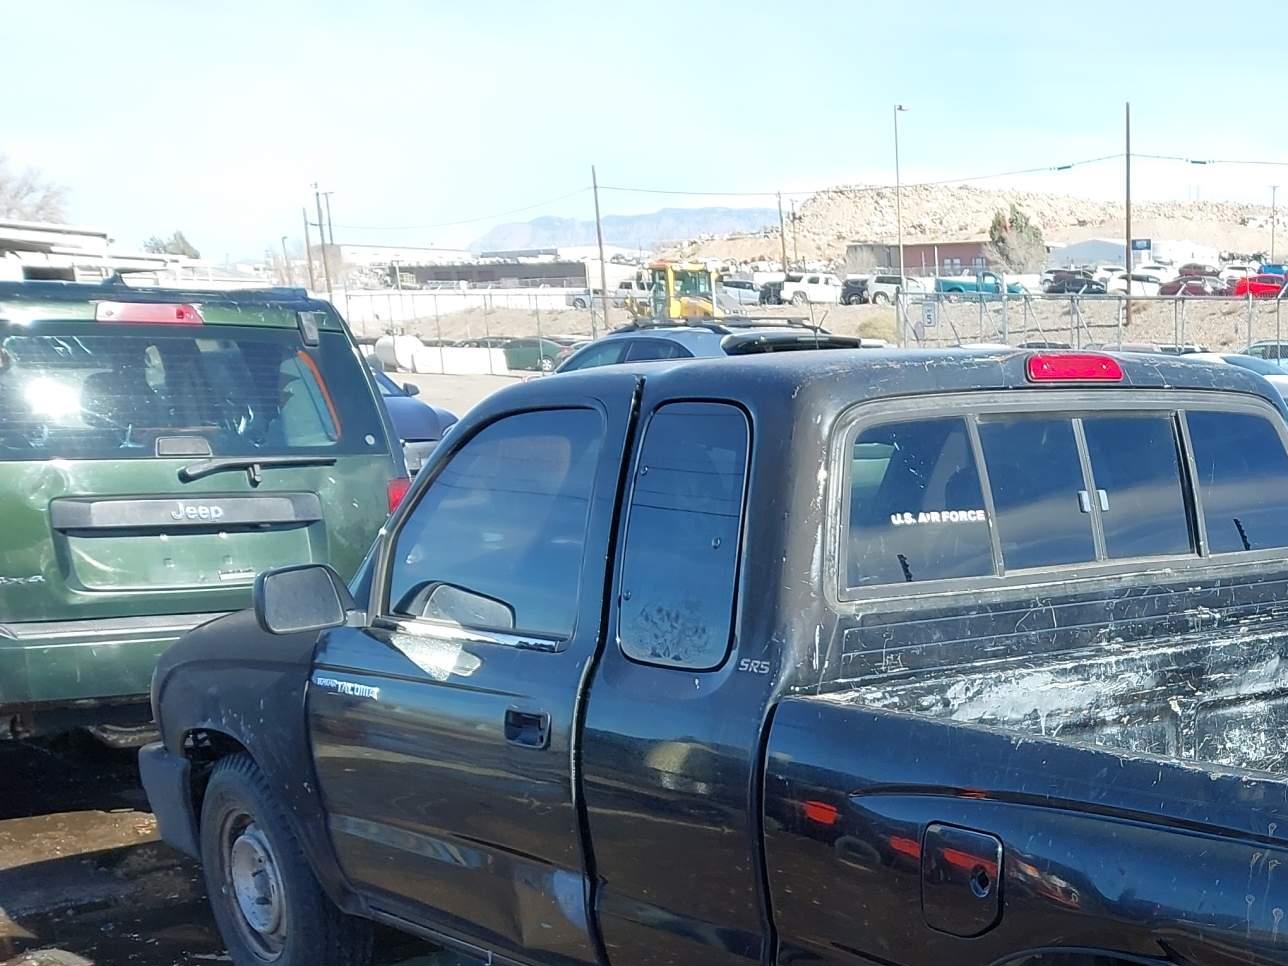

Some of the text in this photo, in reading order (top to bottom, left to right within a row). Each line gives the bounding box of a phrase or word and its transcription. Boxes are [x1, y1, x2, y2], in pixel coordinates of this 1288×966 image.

[170, 501, 224, 522] Jeep
[891, 509, 985, 525] U.S. AIR FORCE
